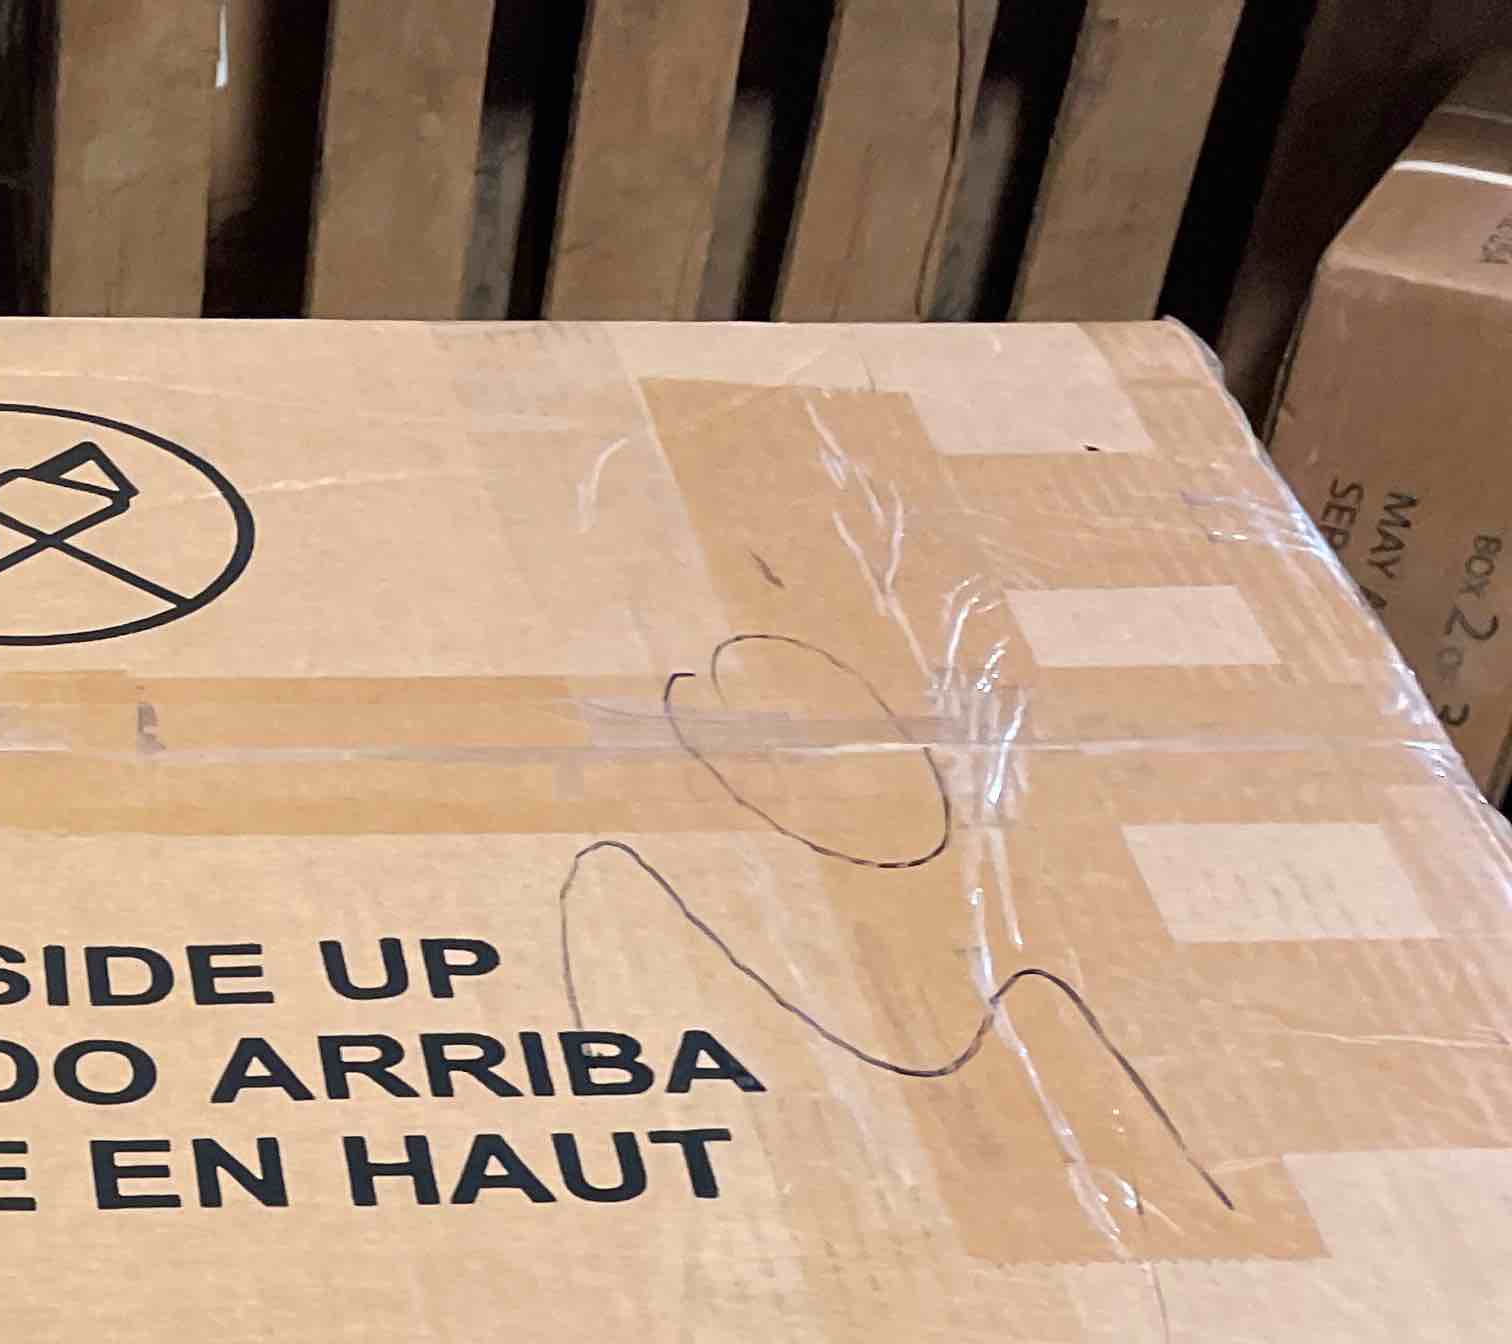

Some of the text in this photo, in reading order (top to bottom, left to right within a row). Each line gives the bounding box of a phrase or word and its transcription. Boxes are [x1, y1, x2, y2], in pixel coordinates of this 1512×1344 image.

[1367, 492, 1419, 579] MAY
[1460, 534, 1502, 597] BOX
[1447, 604, 1499, 640] 2
[319, 937, 501, 1000] UP
[210, 1030, 767, 1103] ARRIBA
[88, 1136, 289, 1210] EN
[342, 1127, 732, 1207] HAUT
